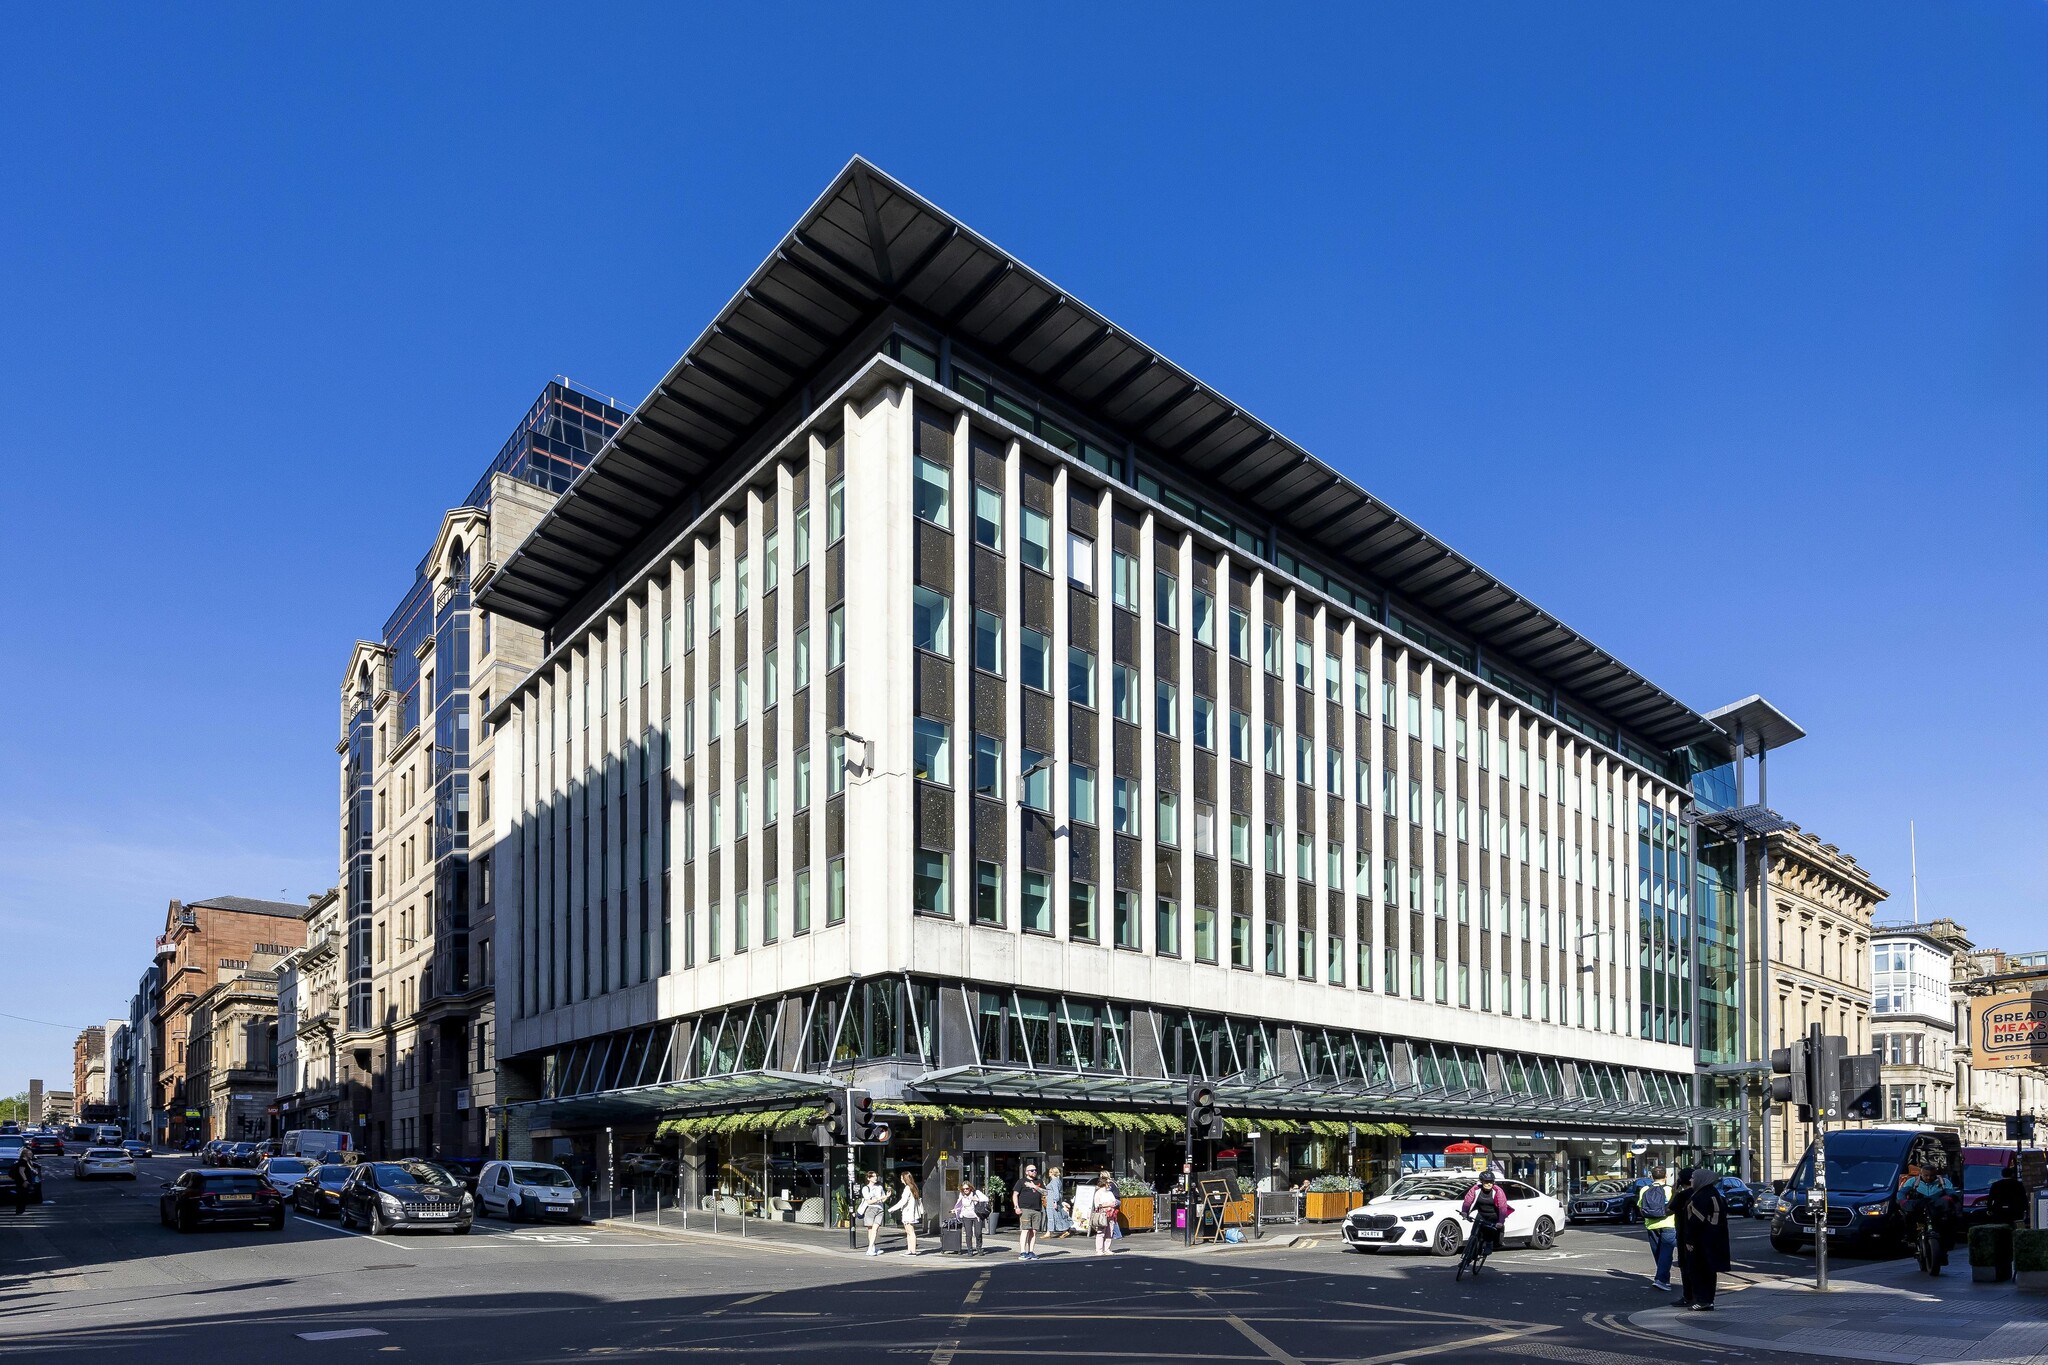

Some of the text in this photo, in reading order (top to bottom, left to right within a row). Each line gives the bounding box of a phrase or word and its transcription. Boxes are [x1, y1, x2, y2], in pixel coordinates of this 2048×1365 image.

[1994, 1010, 2047, 1022] BREAD
[1994, 1021, 2046, 1034] MEATS
[1994, 1032, 2047, 1043] BREAD
[967, 1132, 984, 1140] ALL
[1016, 1132, 1036, 1140] ONE
